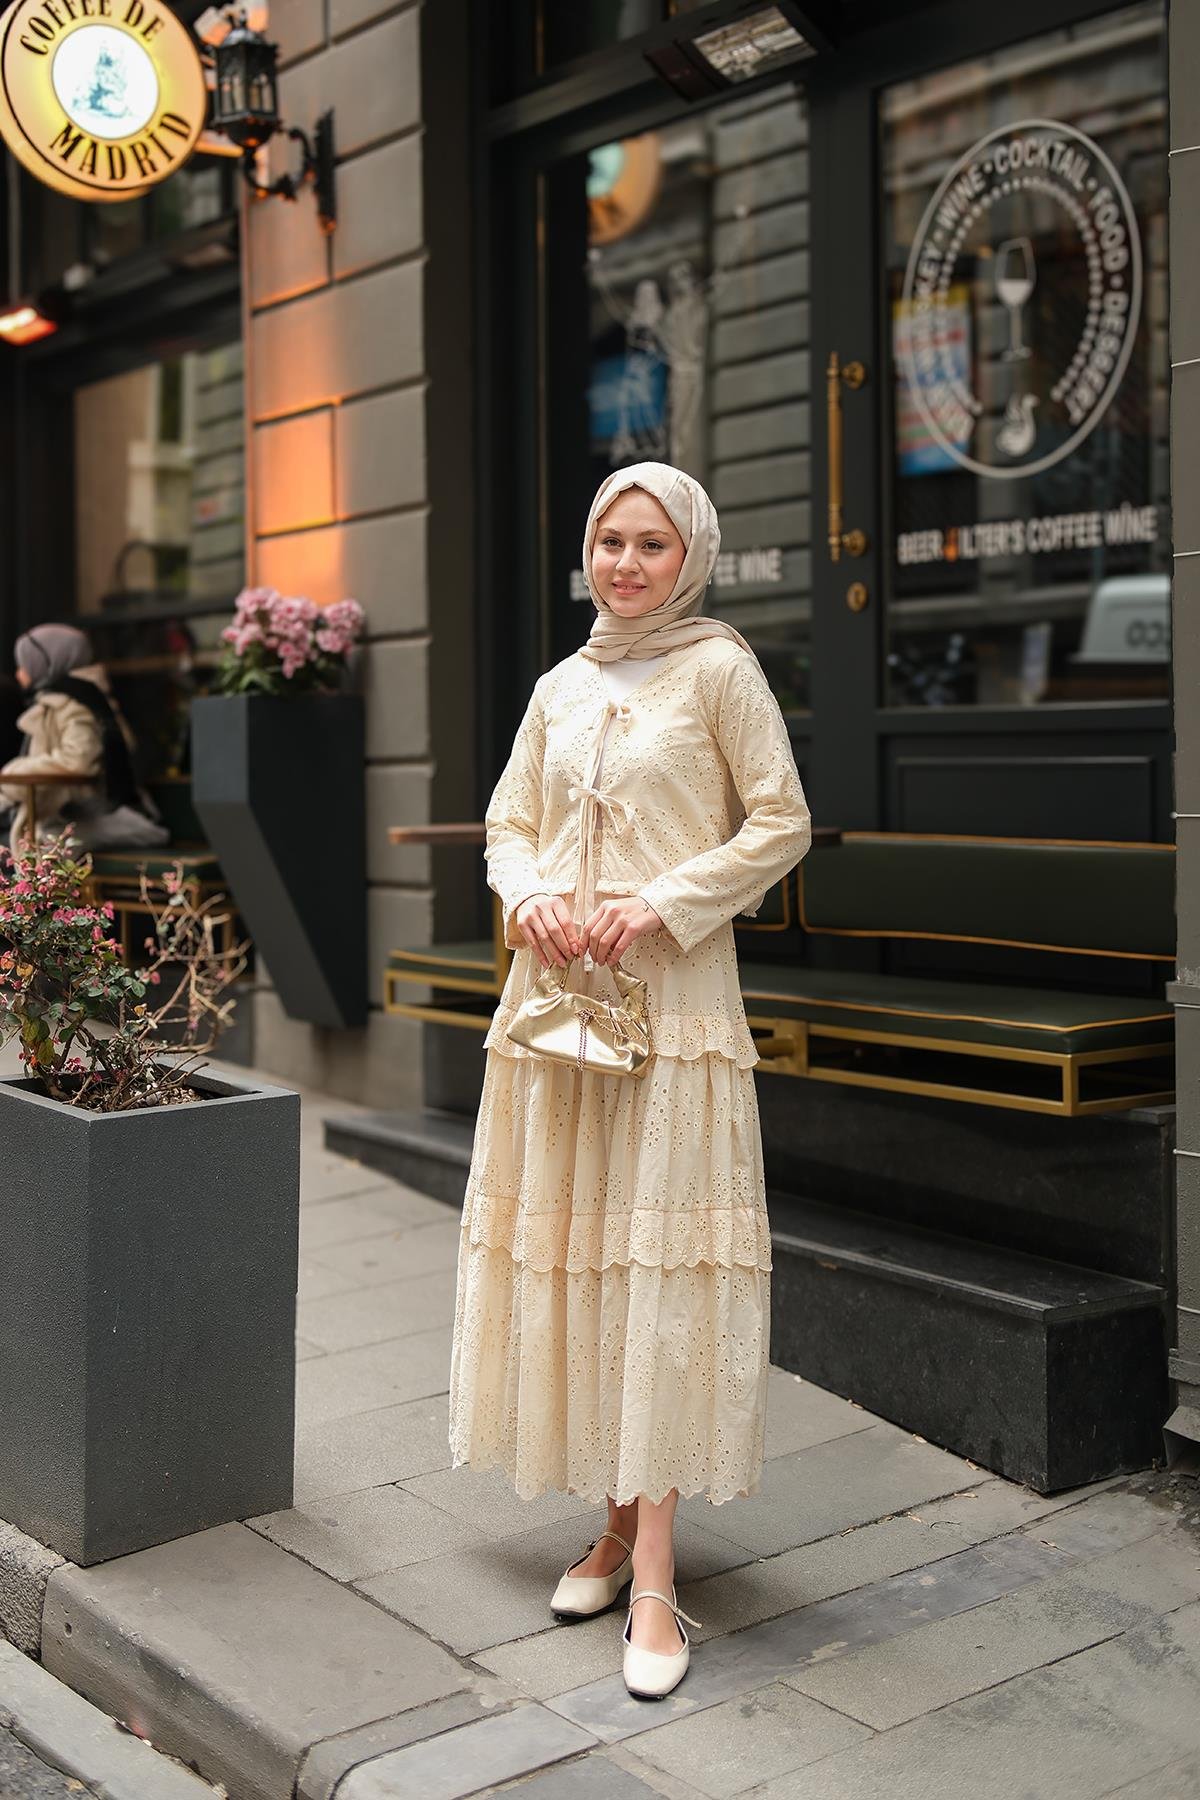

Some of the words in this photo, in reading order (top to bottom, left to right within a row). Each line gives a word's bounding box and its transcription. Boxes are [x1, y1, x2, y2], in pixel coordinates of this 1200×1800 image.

[123, 0, 164, 42] DE
[994, 137, 1091, 192] COCKTAIL
[1089, 186, 1129, 273] FOOD
[1065, 290, 1129, 426] DESSERT
[898, 529, 943, 565] BEER
[1026, 511, 1101, 553] COFFEE
